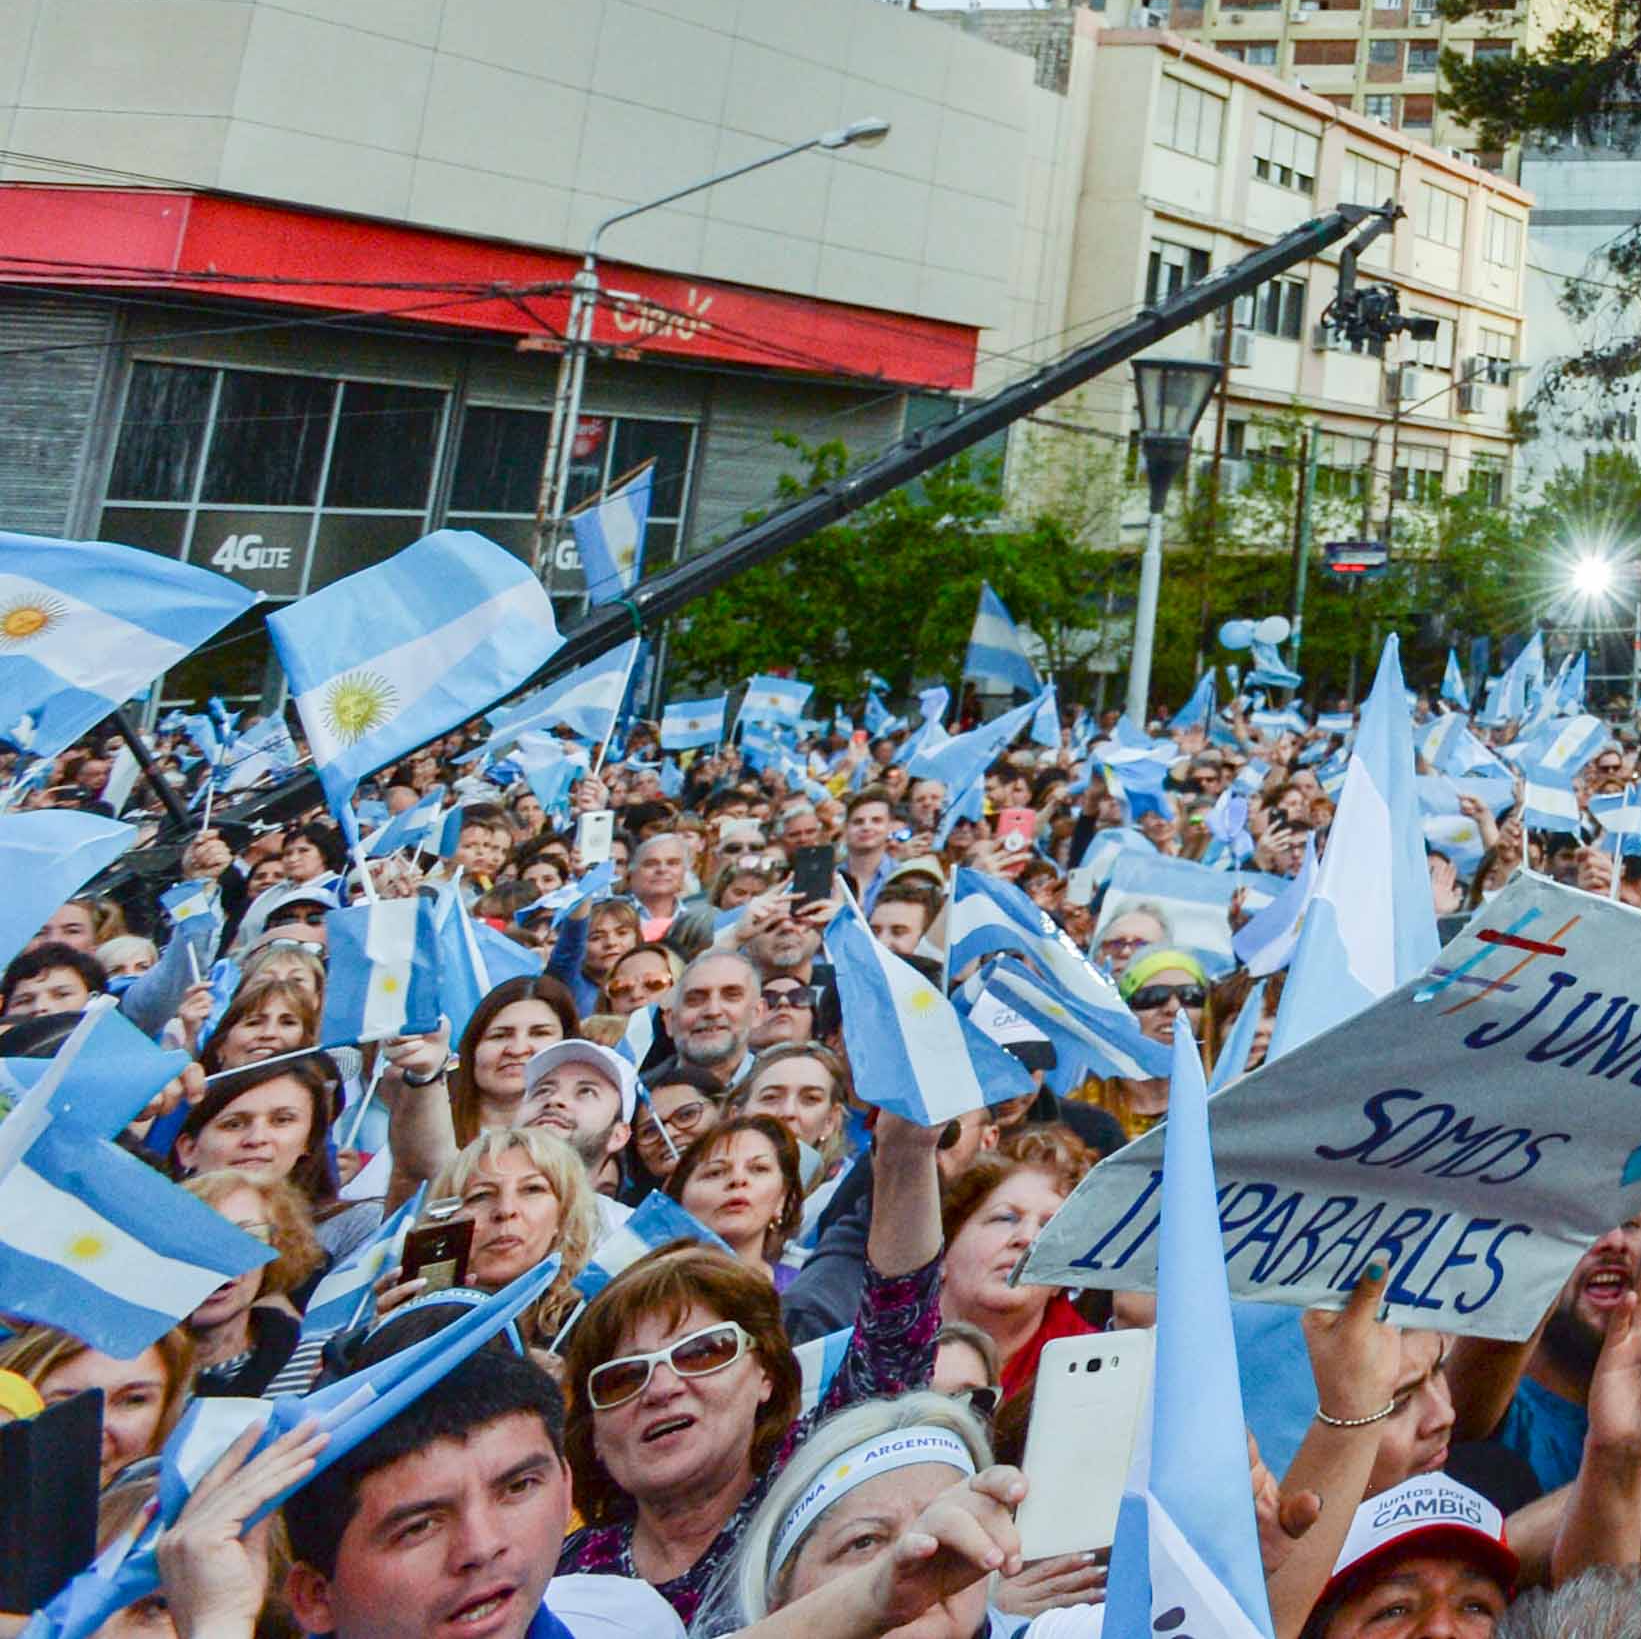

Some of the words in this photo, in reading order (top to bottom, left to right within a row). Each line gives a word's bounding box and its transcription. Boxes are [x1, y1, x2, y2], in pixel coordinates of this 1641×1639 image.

[1315, 1087, 1571, 1185] SOMOS
[1068, 1168, 1533, 1315] IPARABLES
[863, 1436, 962, 1463] ARGENTINA
[1373, 1498, 1482, 1529] CAMBIO
[1375, 1488, 1434, 1514] Juntos
